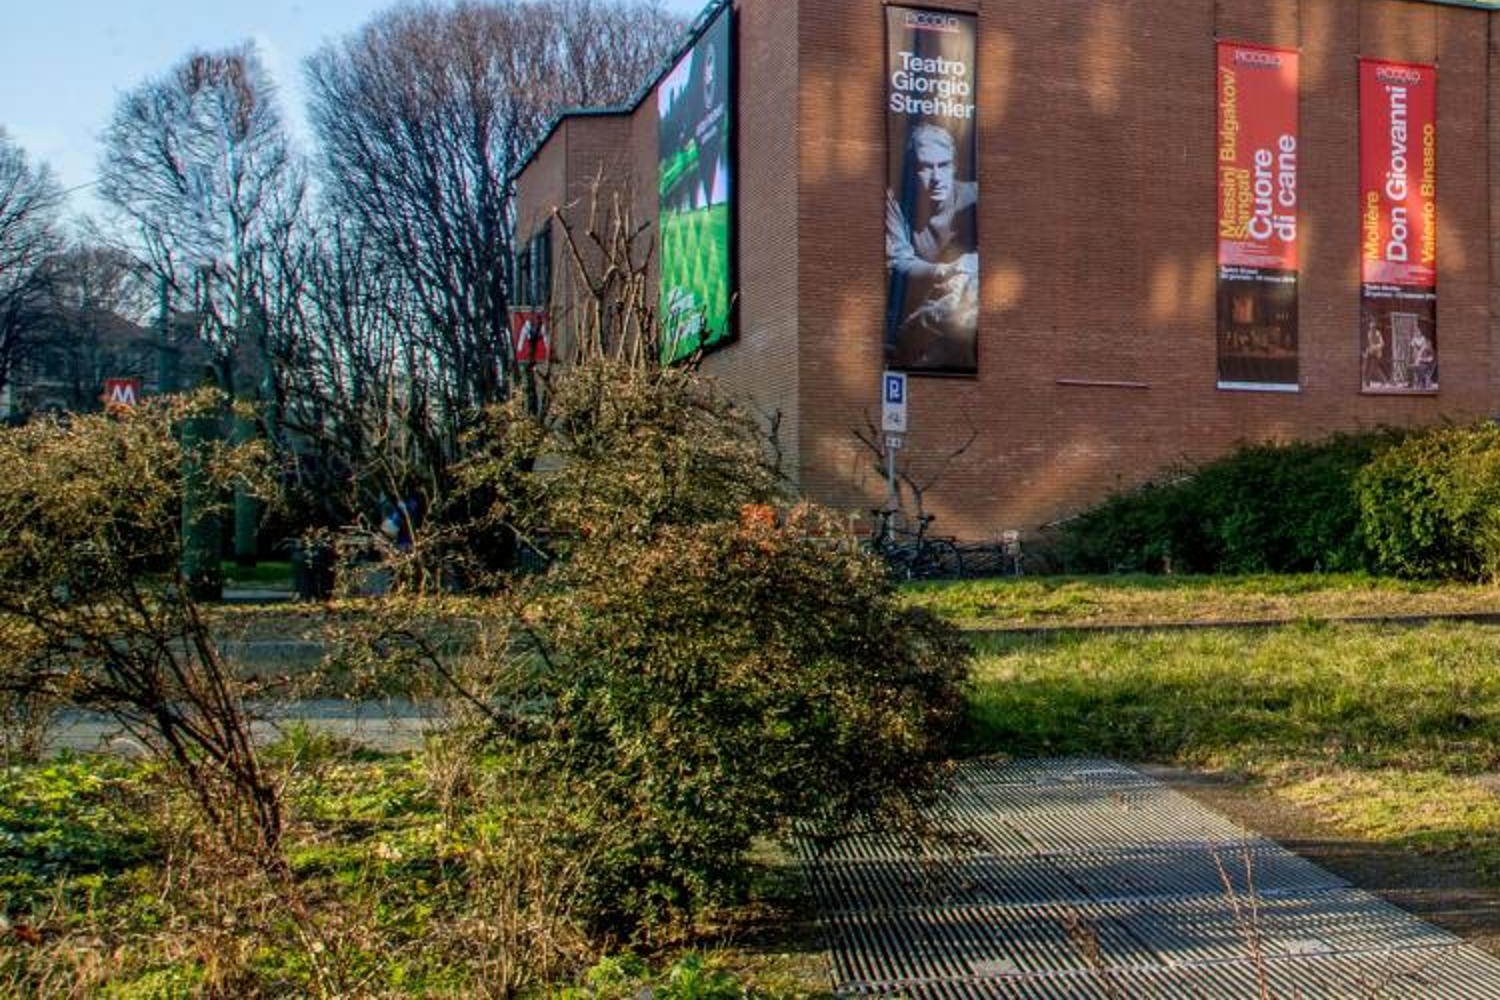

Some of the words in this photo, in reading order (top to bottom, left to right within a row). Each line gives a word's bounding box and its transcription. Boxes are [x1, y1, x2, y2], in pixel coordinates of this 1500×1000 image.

[896, 51, 966, 77] Teatro
[889, 92, 975, 119] Strehler
[891, 71, 970, 99] Giorgio
[1385, 86, 1408, 201] Giovanni
[1421, 124, 1436, 197] Binasco
[1278, 135, 1297, 207] cane
[1247, 149, 1273, 240] Cuore
[1273, 215, 1297, 241] di
[1386, 207, 1408, 262] Don
[111, 384, 136, 406] M
